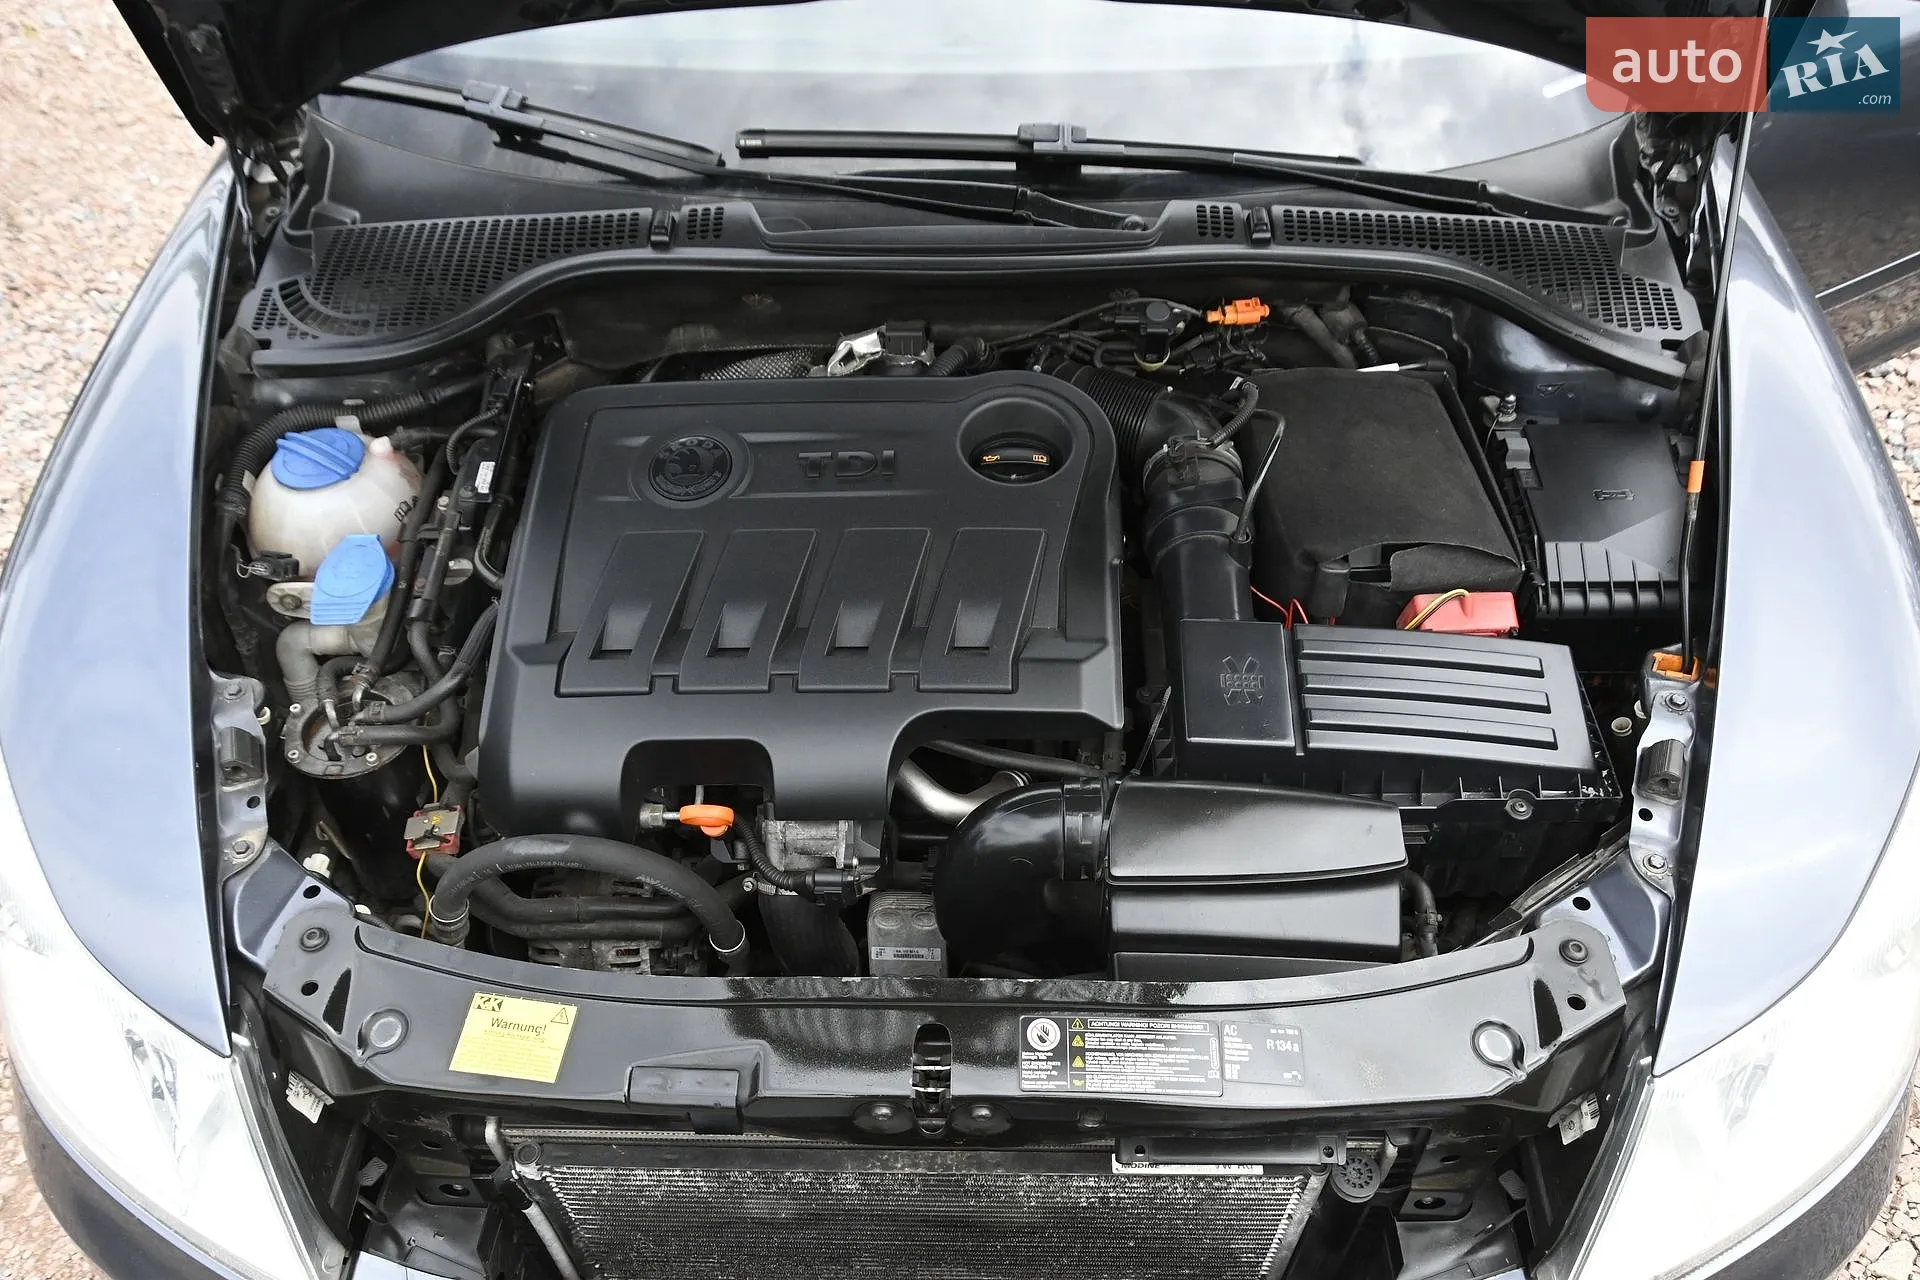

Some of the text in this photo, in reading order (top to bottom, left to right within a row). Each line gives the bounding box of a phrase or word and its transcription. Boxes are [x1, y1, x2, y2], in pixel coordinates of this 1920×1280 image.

[798, 450, 896, 479] TDI
[490, 1017, 547, 1037] Warnung!
[1223, 1024, 1238, 1036] AC
